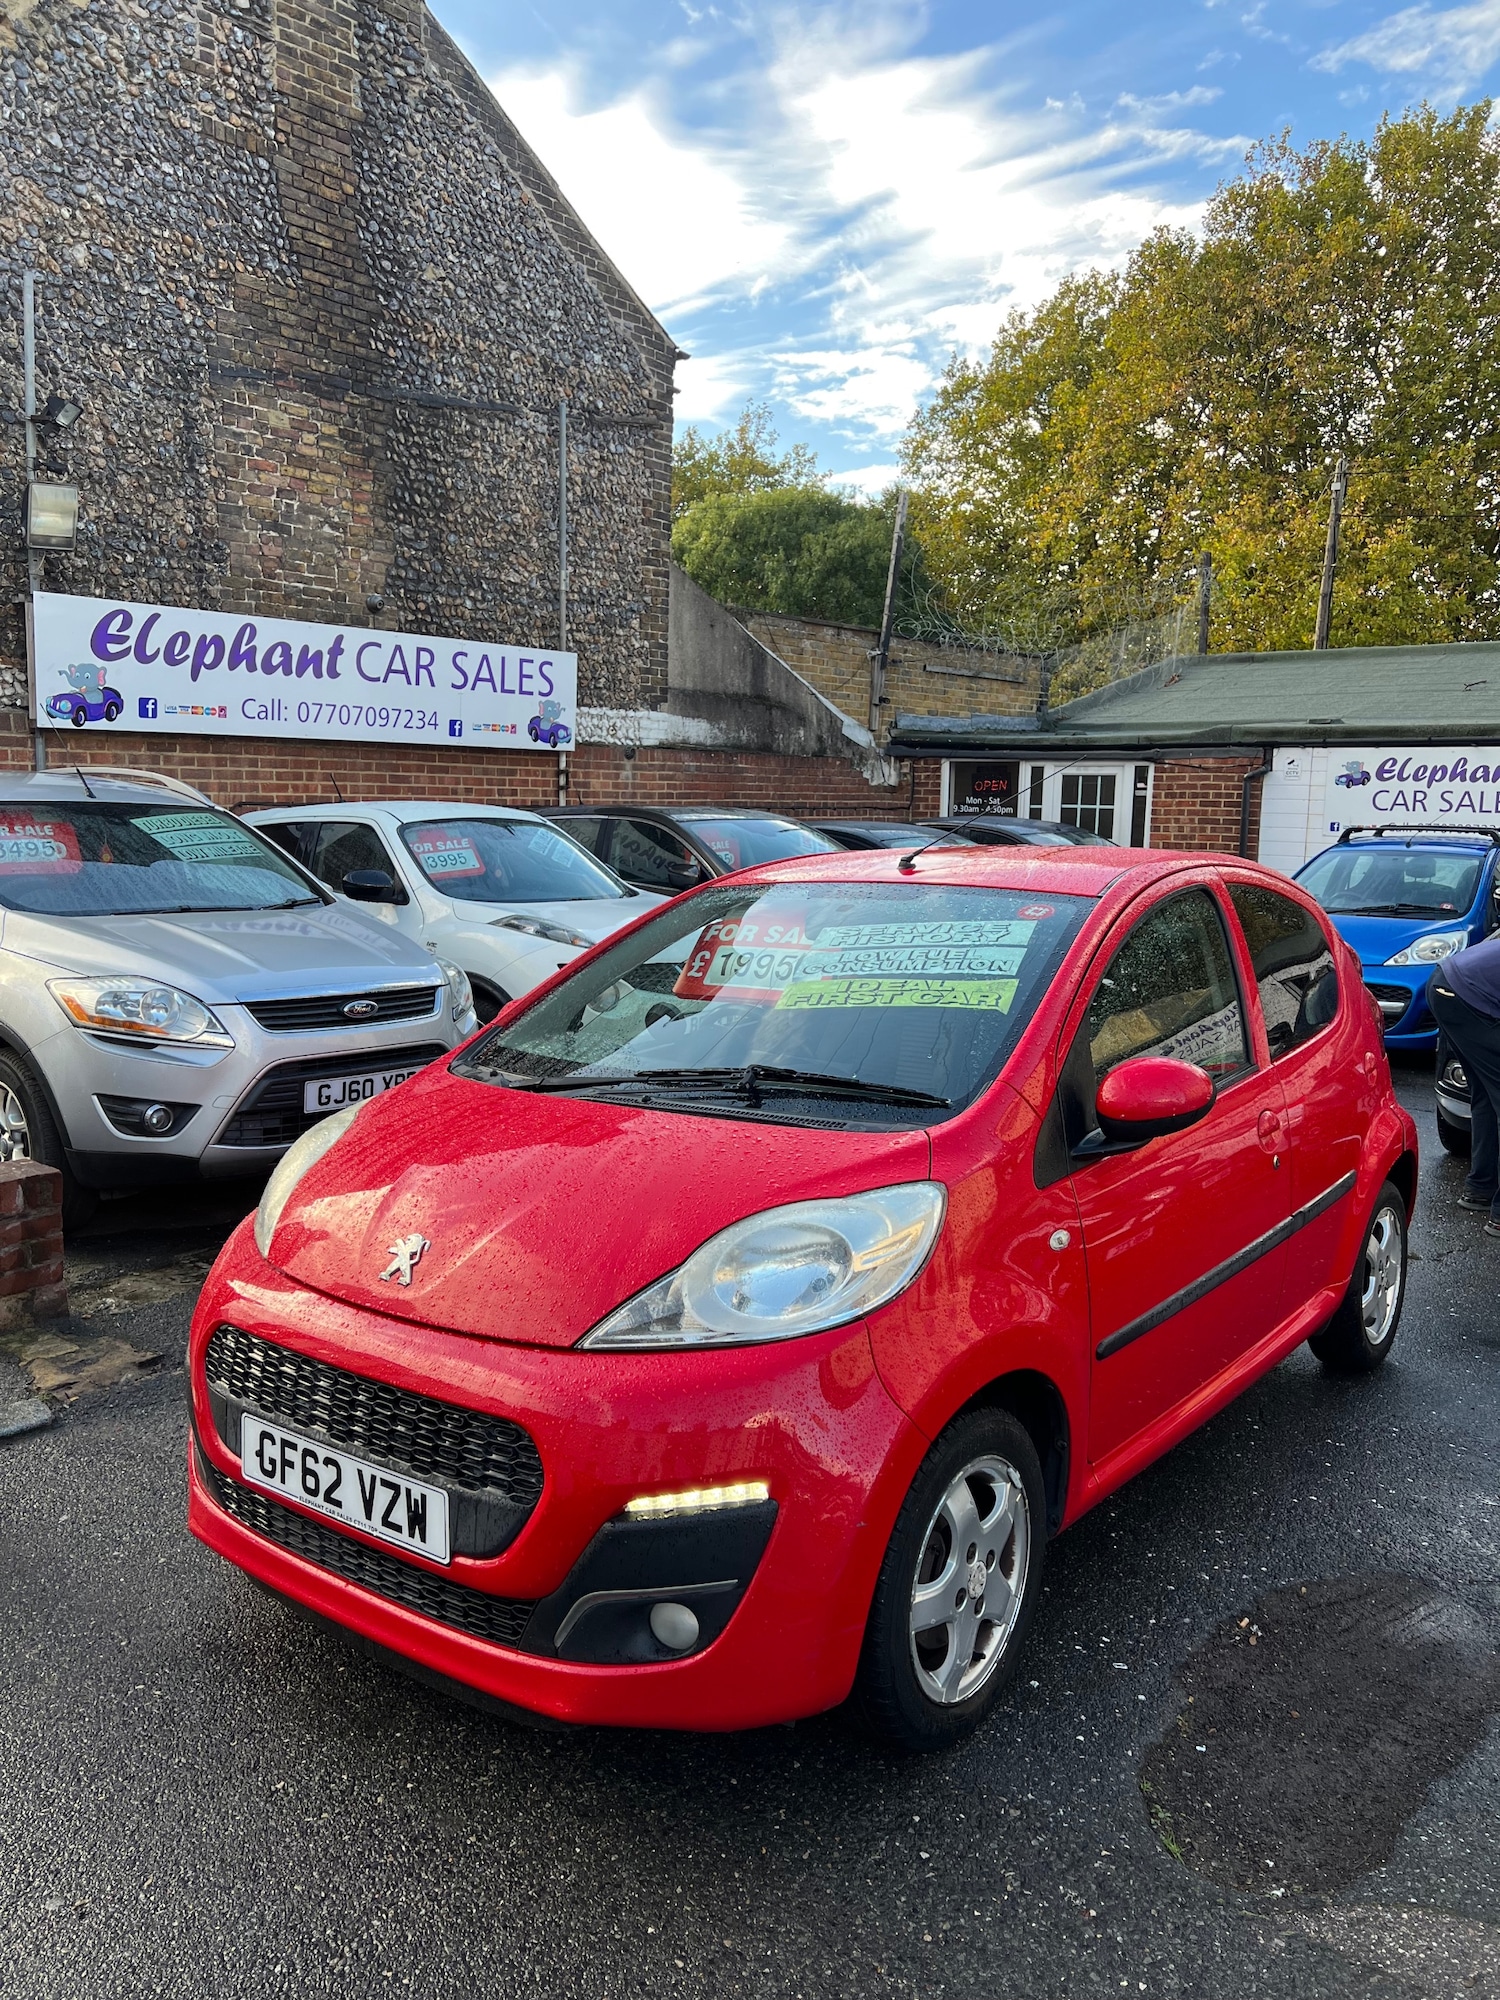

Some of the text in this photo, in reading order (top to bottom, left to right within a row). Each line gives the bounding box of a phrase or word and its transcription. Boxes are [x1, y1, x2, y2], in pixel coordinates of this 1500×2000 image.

[90, 608, 554, 697] Elephant CAR SALES
[241, 698, 288, 722] Call:
[297, 701, 439, 731] 07707097234
[974, 780, 1008, 791] OPEN
[953, 804, 980, 813] 9.30am
[965, 796, 983, 804] Mon
[988, 796, 1001, 805] Sat
[1372, 790, 1500, 813] CAR SALE
[14, 825, 54, 836] SALE
[409, 838, 469, 852] OR SALE
[711, 840, 730, 850] SALE
[427, 852, 467, 868] 3995
[703, 924, 815, 945] FOR SAL
[836, 922, 1012, 935] SERVICE
[829, 932, 1010, 947] HISTORY
[840, 948, 982, 963] LOW FUEL
[687, 951, 799, 981] £ 1995
[802, 958, 1014, 975] CONSUMPTION
[836, 979, 955, 994] IDEAL
[786, 990, 1004, 1007] FIRST CAR
[318, 1078, 374, 1107] GJ60
[258, 1430, 427, 1544] GF62 VZW
[299, 1496, 324, 1511] ELEPHANT
[325, 1507, 336, 1516] CAR
[336, 1512, 352, 1522] SALES
